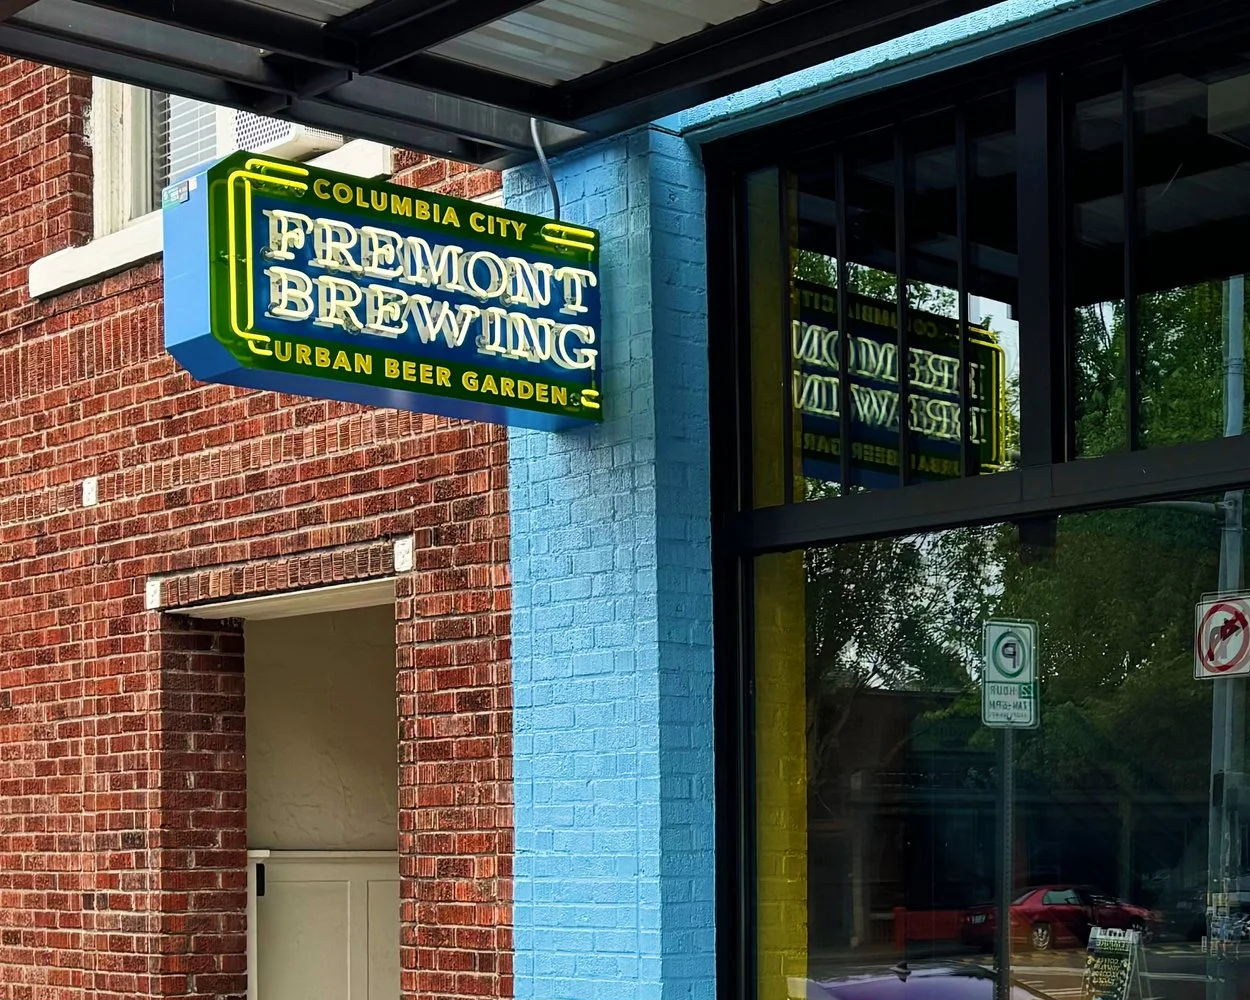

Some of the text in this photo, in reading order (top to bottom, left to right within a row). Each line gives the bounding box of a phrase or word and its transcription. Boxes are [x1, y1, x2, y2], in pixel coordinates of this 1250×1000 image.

[312, 178, 528, 242] COLUMBIA CITY
[262, 208, 598, 316] FREMONT
[264, 266, 599, 371] BREWING
[274, 340, 569, 407] URBAN BEER GARDEN
